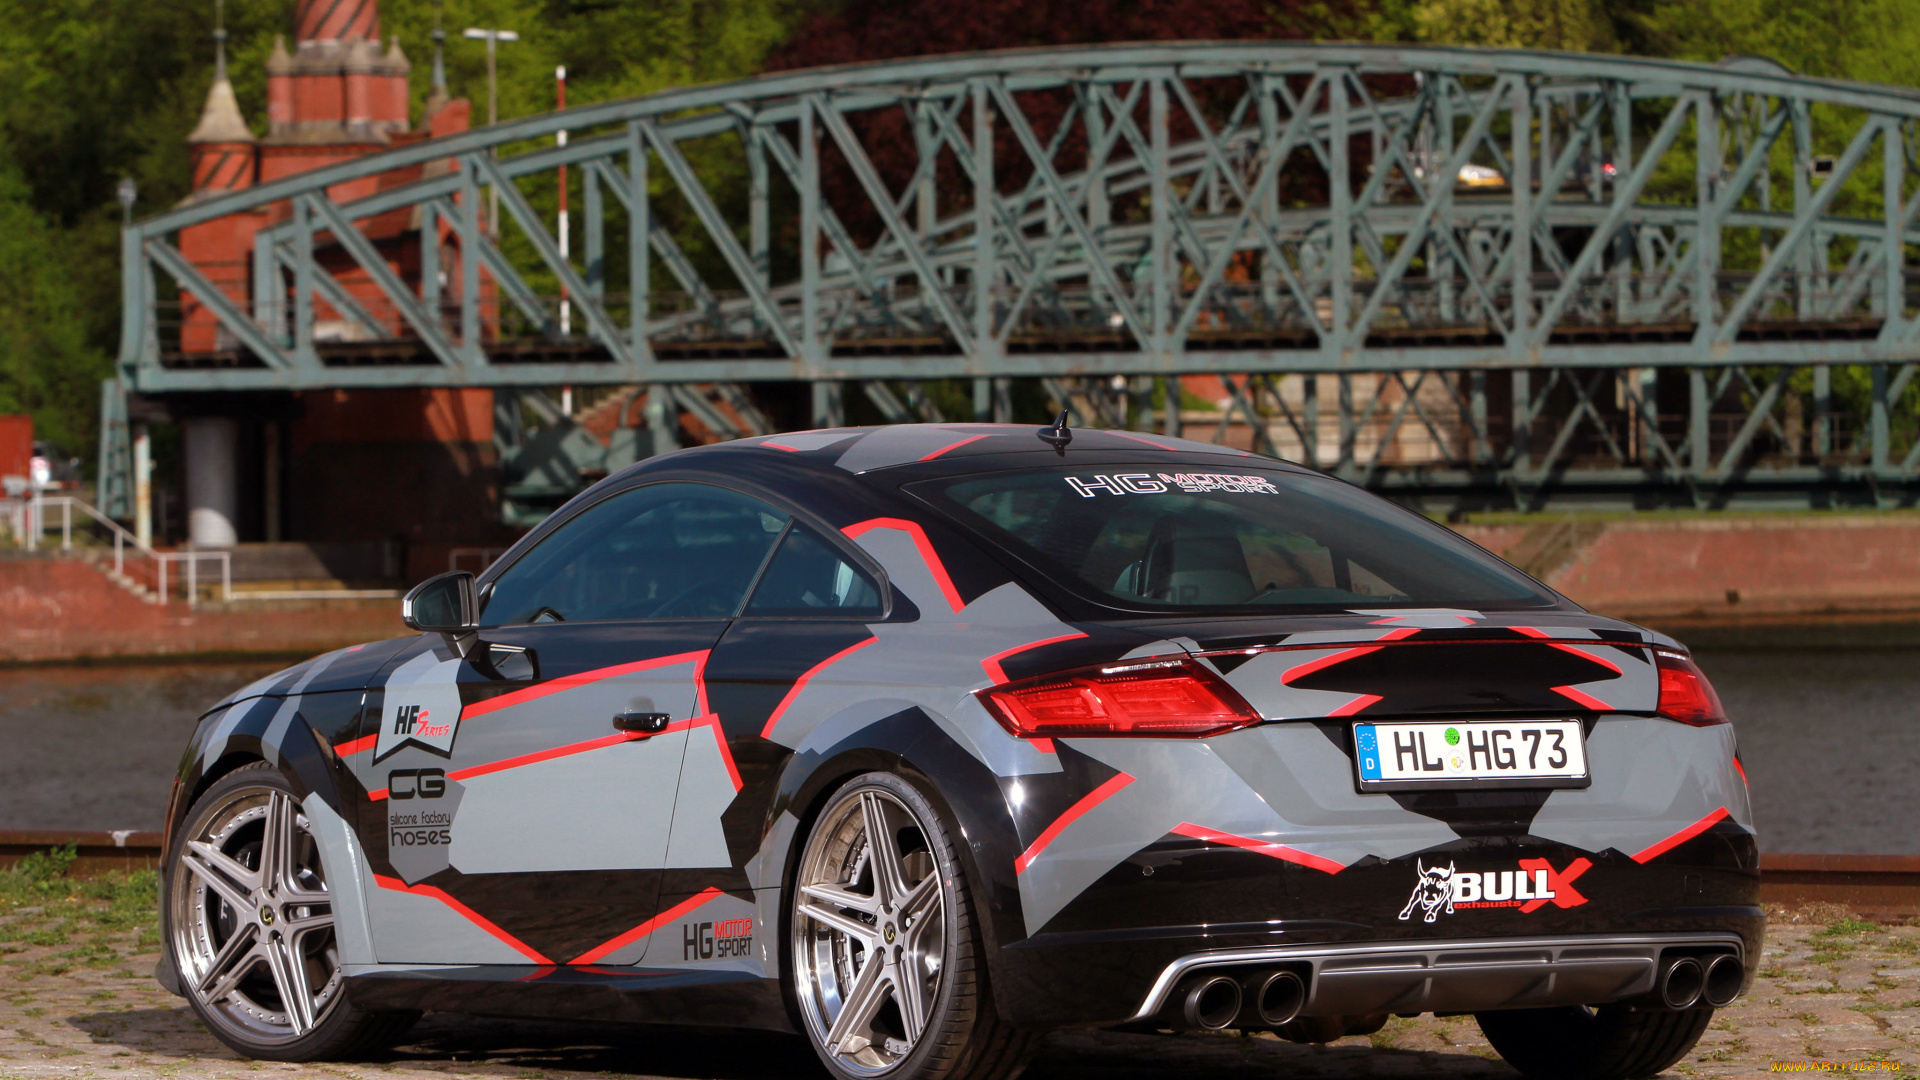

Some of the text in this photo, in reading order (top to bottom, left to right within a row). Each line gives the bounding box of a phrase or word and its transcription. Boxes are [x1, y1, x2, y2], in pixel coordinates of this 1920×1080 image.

[1064, 473, 1168, 498] HG
[1156, 473, 1268, 485] MOTOR
[1178, 481, 1279, 495] SPORT
[394, 705, 420, 735] HF
[1393, 730, 1443, 771] HL
[1365, 758, 1375, 770] D
[388, 768, 445, 799] CG
[390, 810, 450, 826] silicone factory
[391, 827, 451, 846] hoses
[1454, 899, 1522, 909] exhausts
[714, 918, 752, 939] MOTOR
[683, 922, 713, 960] HG
[717, 937, 752, 957] SPORT
